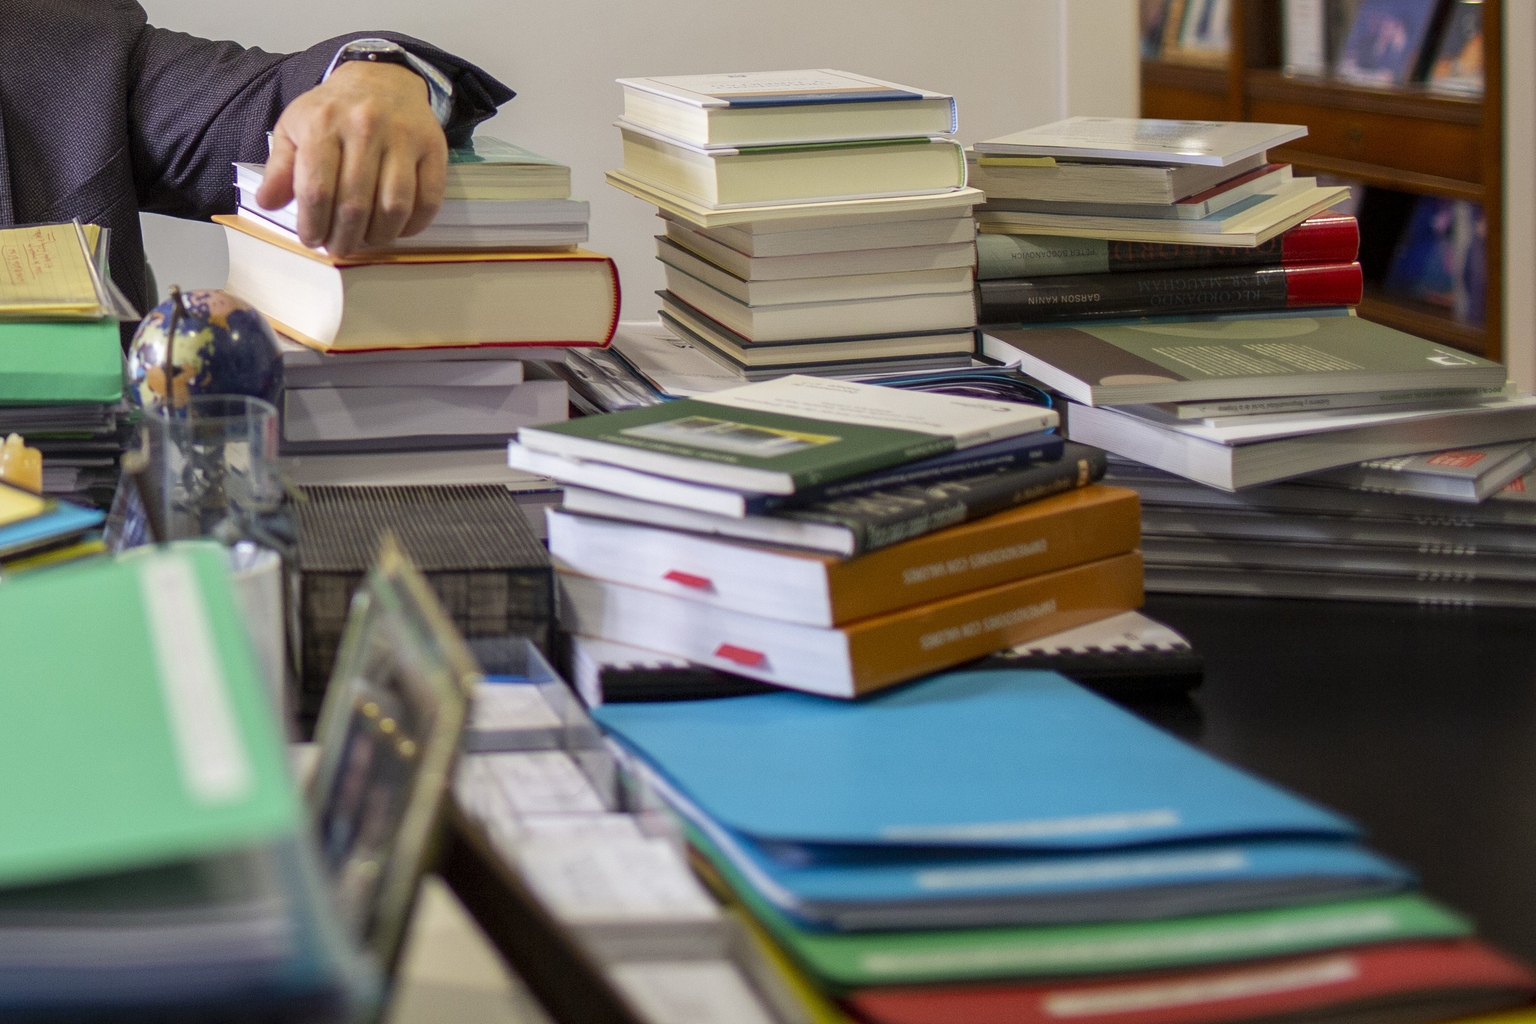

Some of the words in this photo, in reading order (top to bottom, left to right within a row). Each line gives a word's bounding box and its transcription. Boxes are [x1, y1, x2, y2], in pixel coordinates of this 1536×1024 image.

[1011, 250, 1068, 260] BOGDANOVICH
[1070, 248, 1095, 257] PETER
[1137, 277, 1221, 292] MAUGHAM
[1027, 295, 1058, 305] KANIN
[1061, 293, 1101, 303] GARSON
[1150, 289, 1260, 306] RECORDANDO
